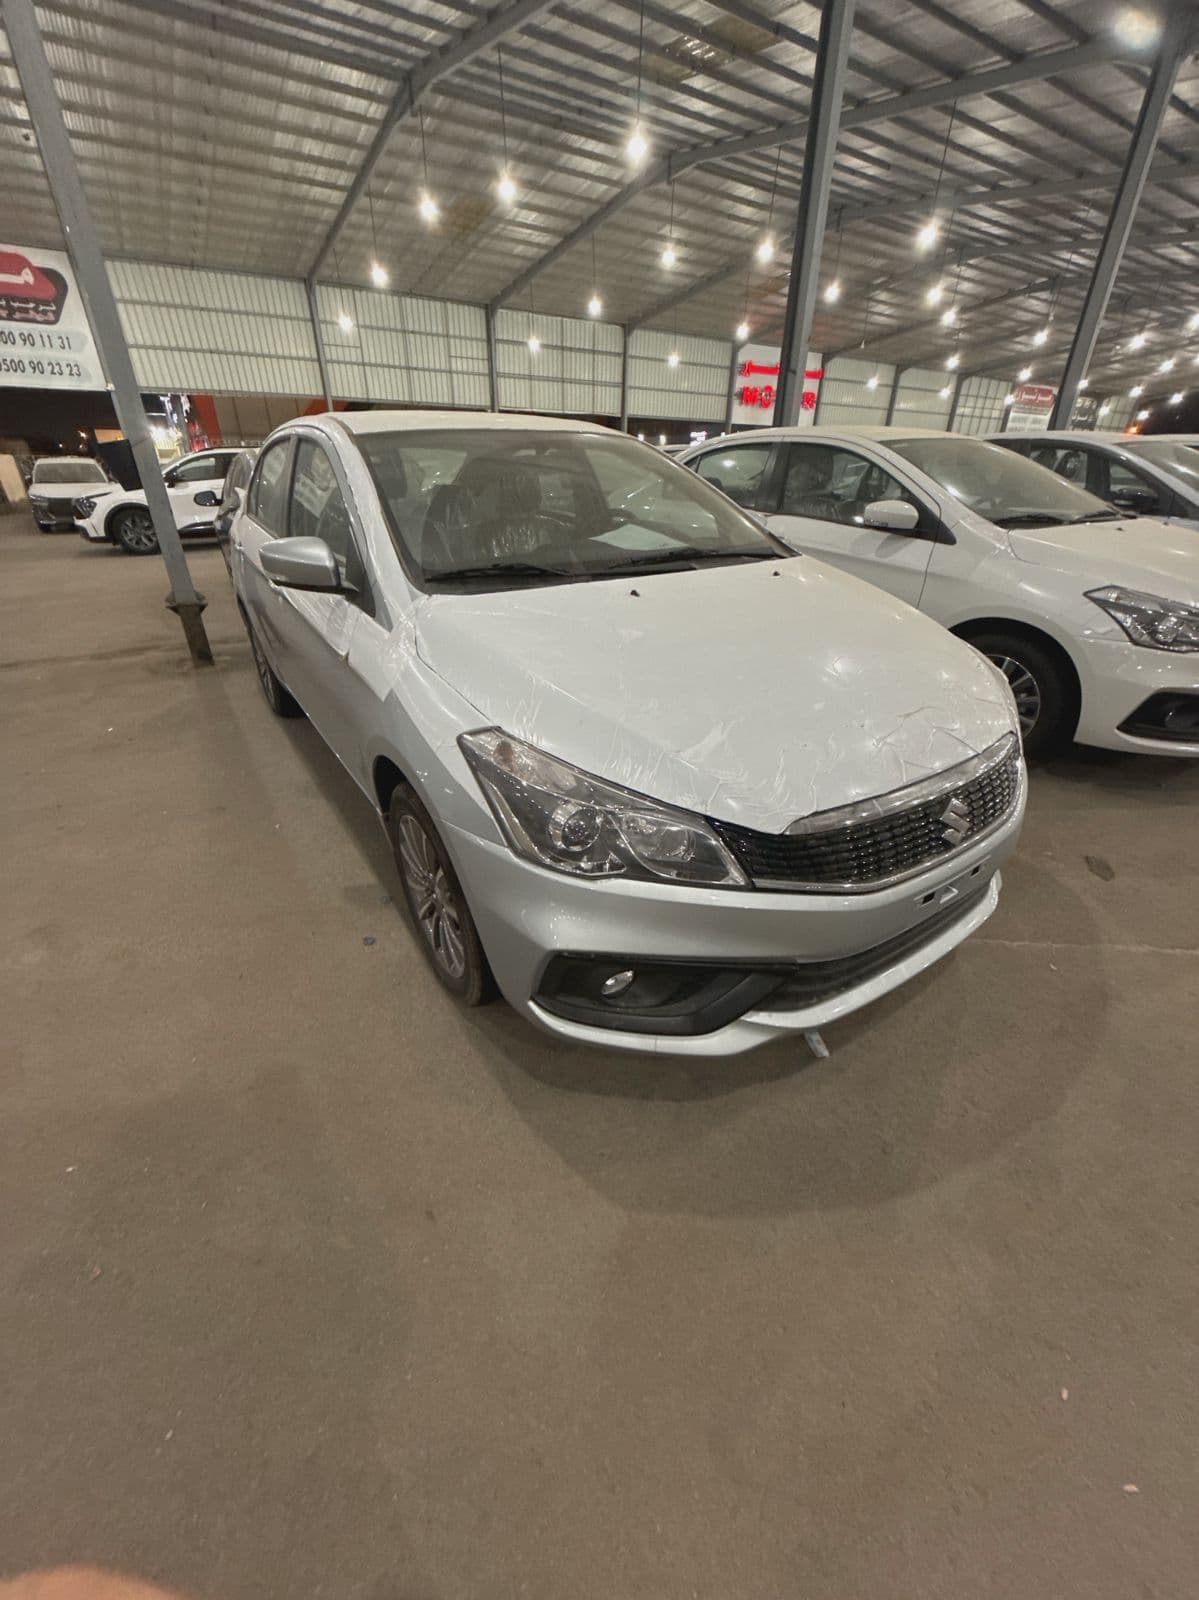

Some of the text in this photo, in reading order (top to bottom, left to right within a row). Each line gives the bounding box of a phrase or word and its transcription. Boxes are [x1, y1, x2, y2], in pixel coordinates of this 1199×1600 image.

[18, 332, 35, 347] 90
[39, 334, 53, 348] 11
[57, 336, 71, 350] 31
[28, 360, 45, 374] 90
[47, 361, 64, 376] 23
[66, 363, 82, 377] 23
